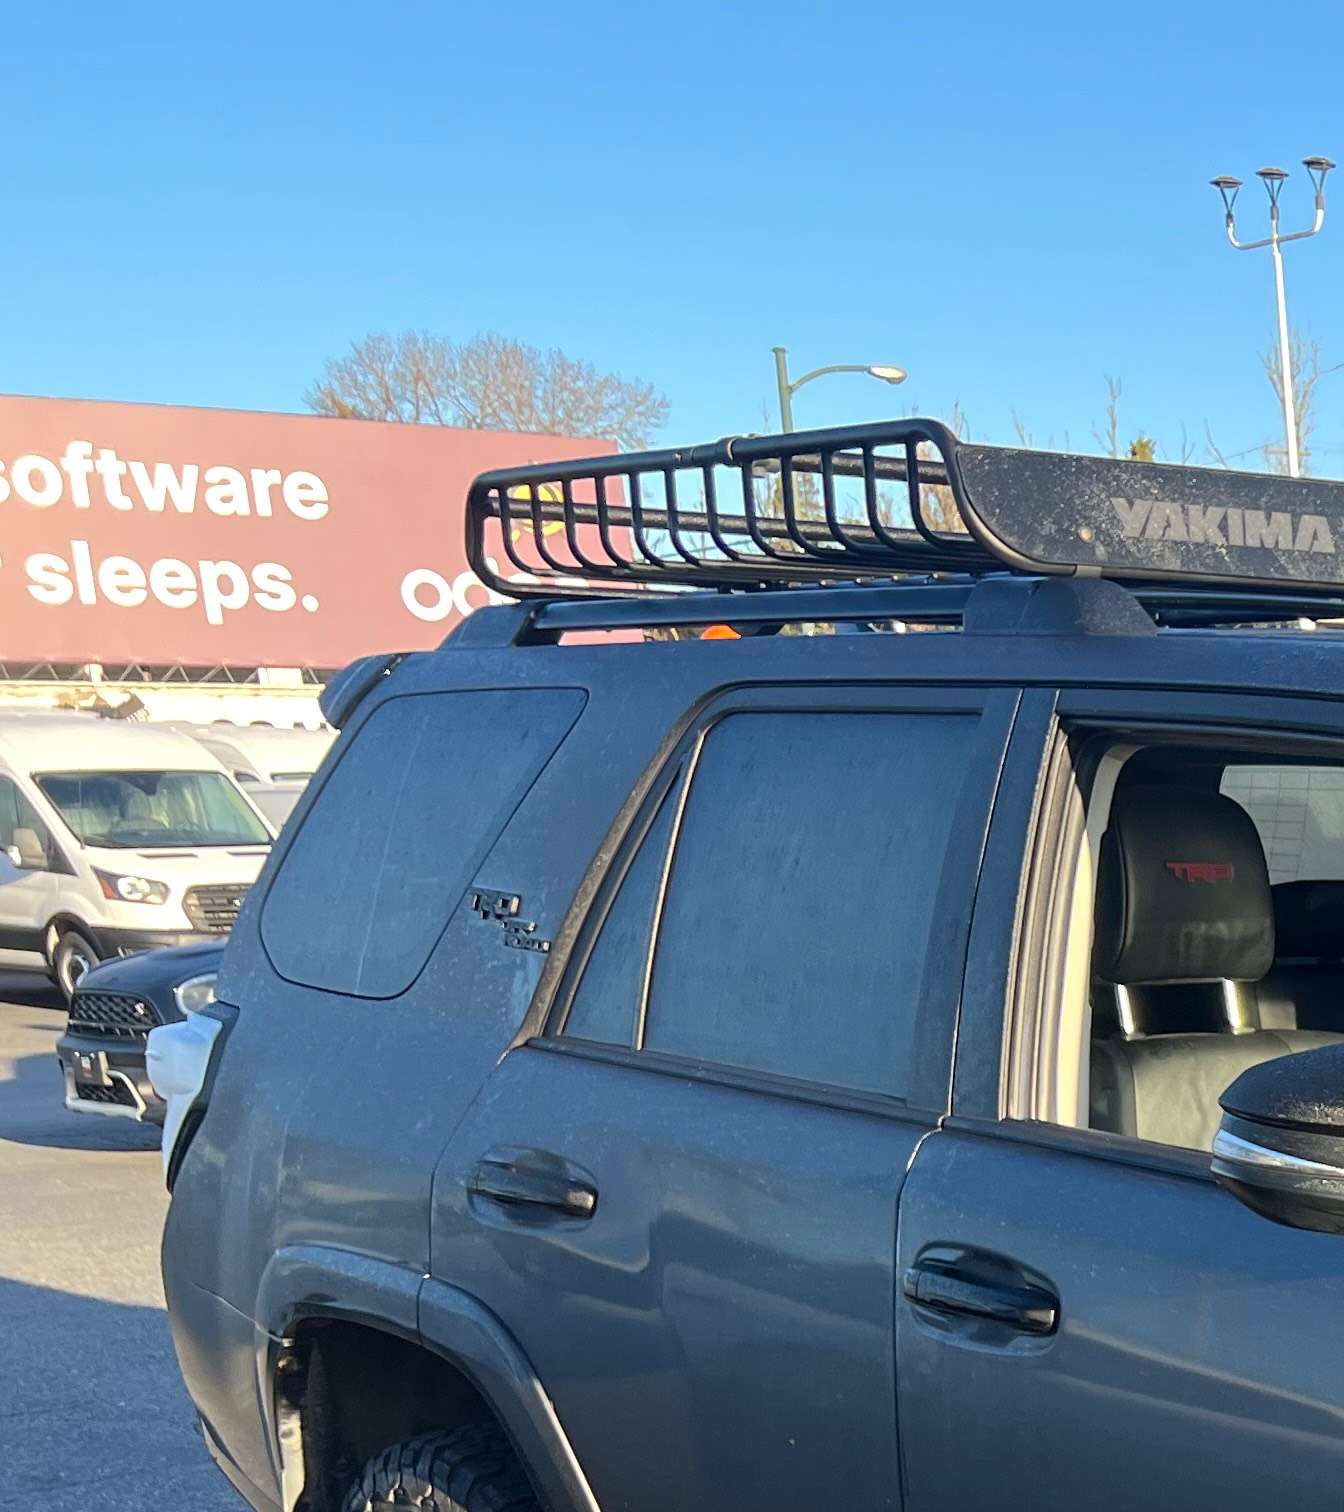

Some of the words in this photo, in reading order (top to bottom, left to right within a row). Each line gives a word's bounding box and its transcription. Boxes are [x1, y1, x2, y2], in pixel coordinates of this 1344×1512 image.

[0, 440, 329, 520] oftware
[1110, 497, 1336, 553] YAKIMA
[25, 539, 320, 624] sleeps.
